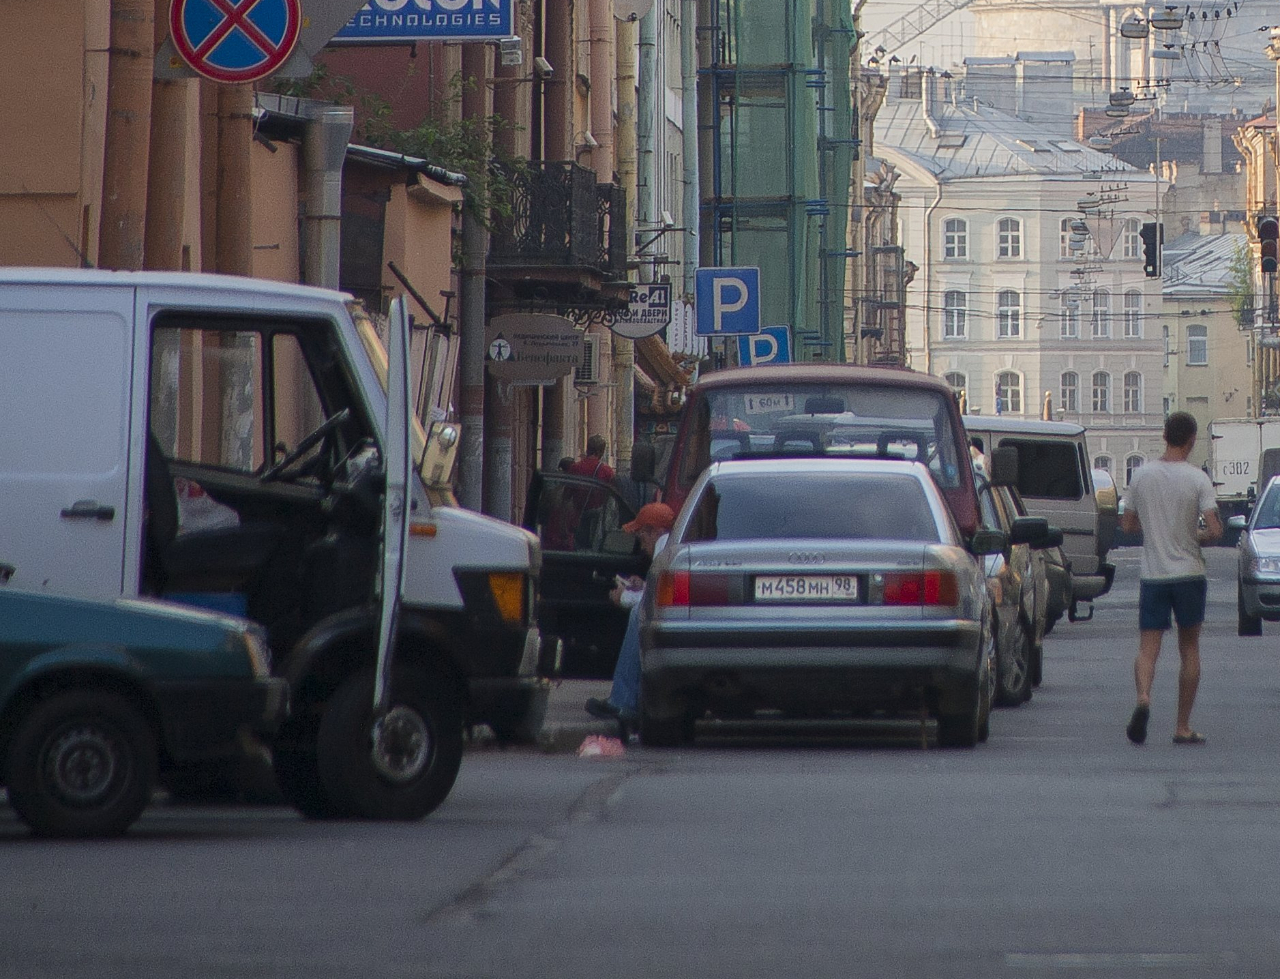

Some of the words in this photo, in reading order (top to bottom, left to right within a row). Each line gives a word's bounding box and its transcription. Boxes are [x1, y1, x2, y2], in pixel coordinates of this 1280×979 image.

[346, 12, 501, 27] ECHNOLOGIES
[713, 277, 749, 331] P
[641, 308, 668, 319] ДВЕРИ
